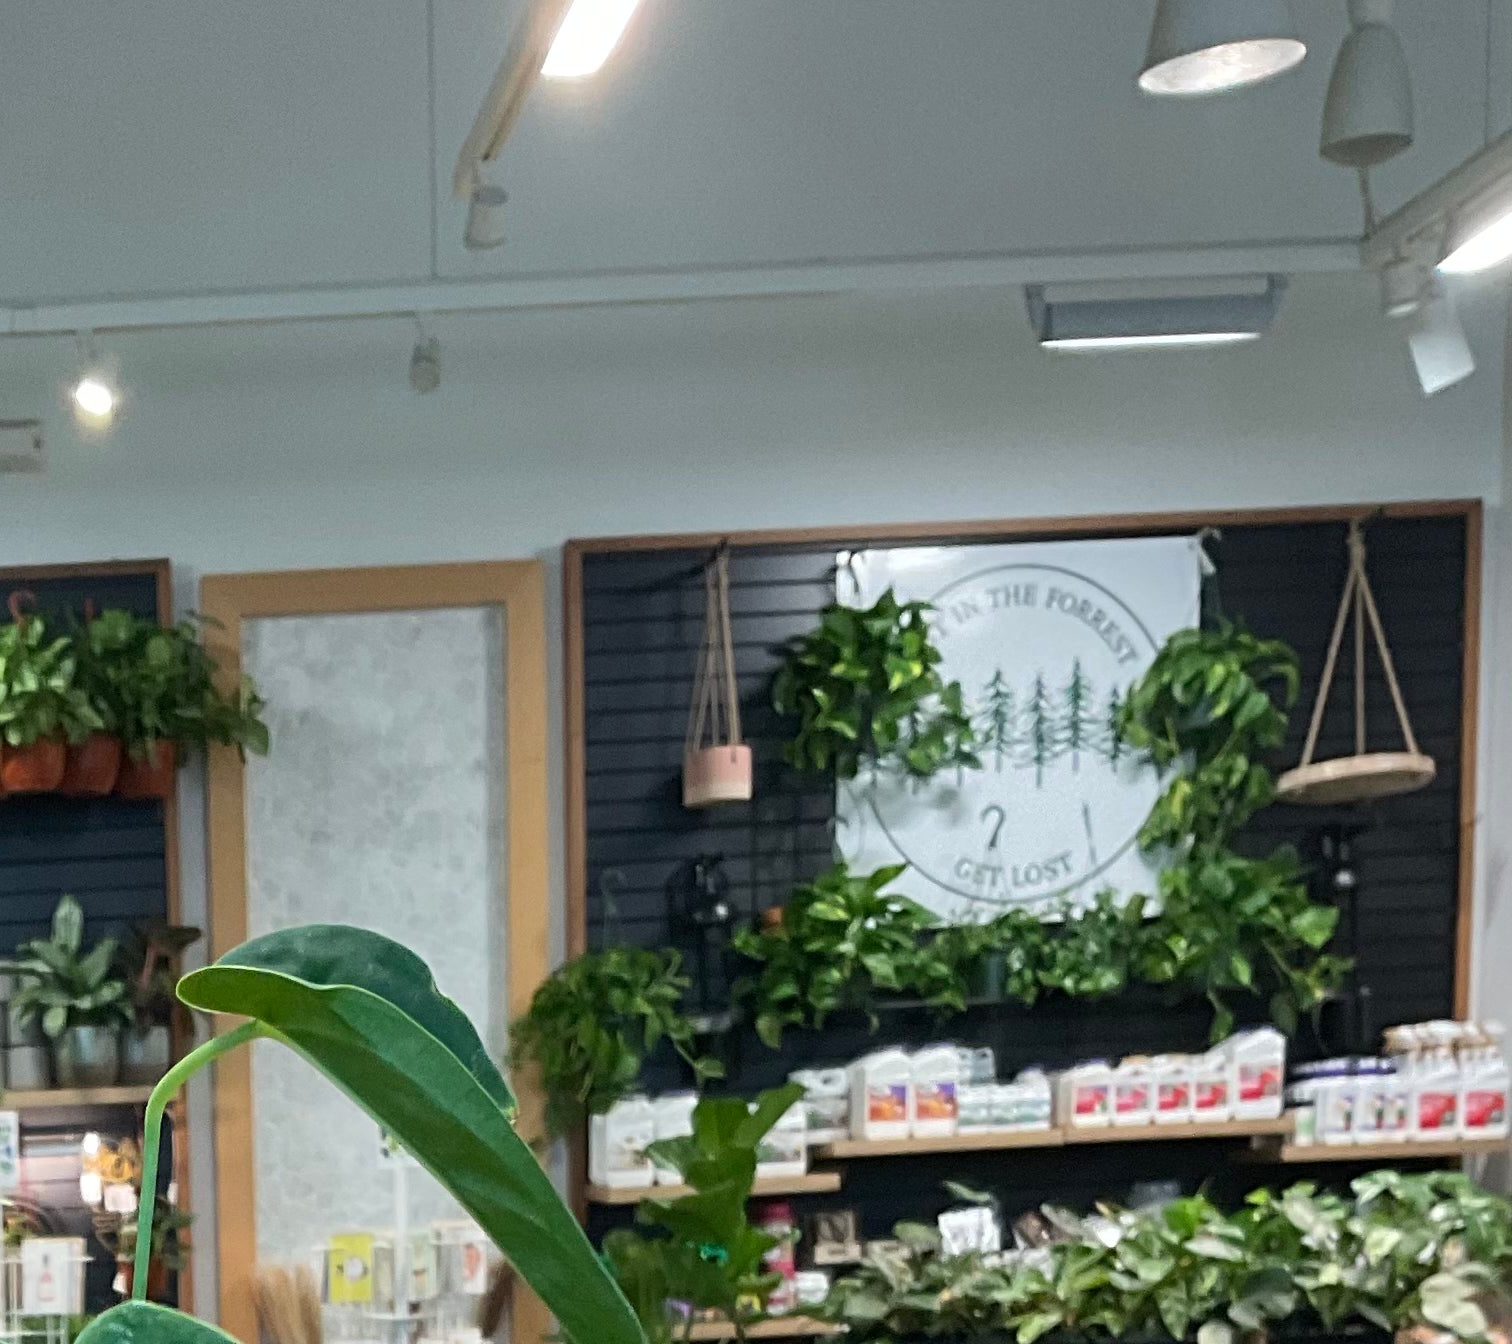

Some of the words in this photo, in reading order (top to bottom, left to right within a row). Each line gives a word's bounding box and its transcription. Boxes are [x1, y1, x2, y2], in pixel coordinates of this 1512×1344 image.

[987, 584, 1037, 609] THE
[1045, 586, 1137, 665] FORREST
[954, 857, 1003, 888] GET
[1011, 849, 1073, 887] LOST
